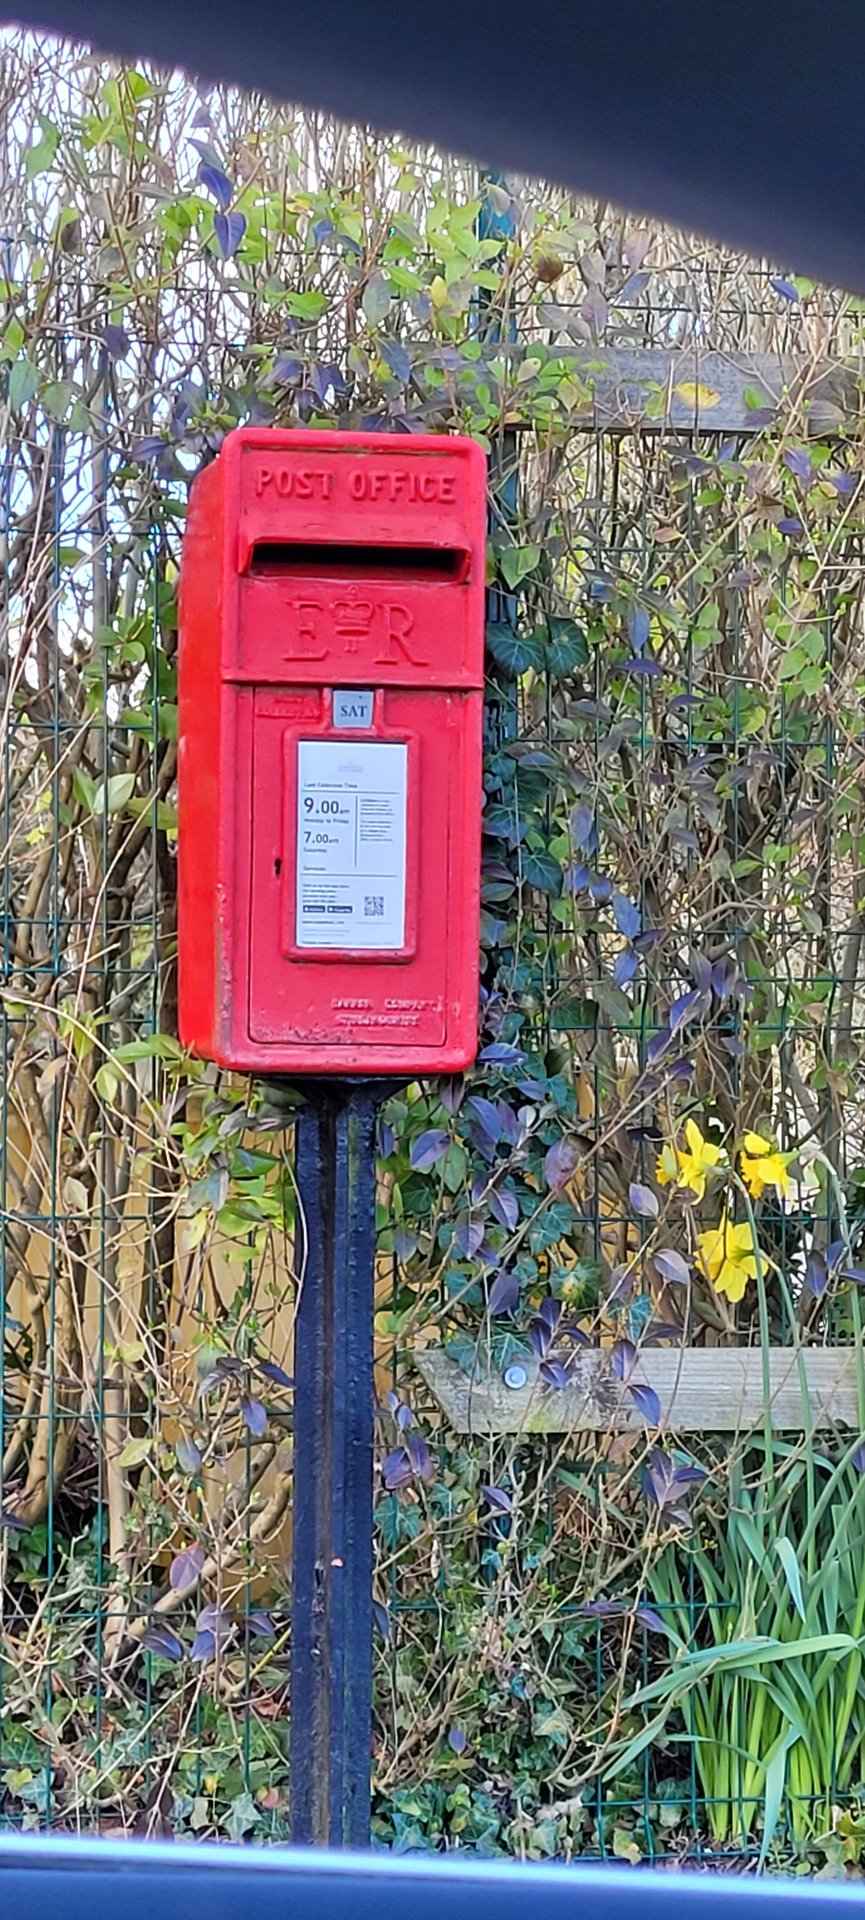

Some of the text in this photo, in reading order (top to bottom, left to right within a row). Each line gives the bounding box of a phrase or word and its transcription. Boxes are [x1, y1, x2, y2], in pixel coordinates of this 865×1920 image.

[255, 466, 457, 504] POST OFFICE
[281, 599, 329, 664] E
[372, 601, 430, 667] R
[340, 704, 368, 718] SAT
